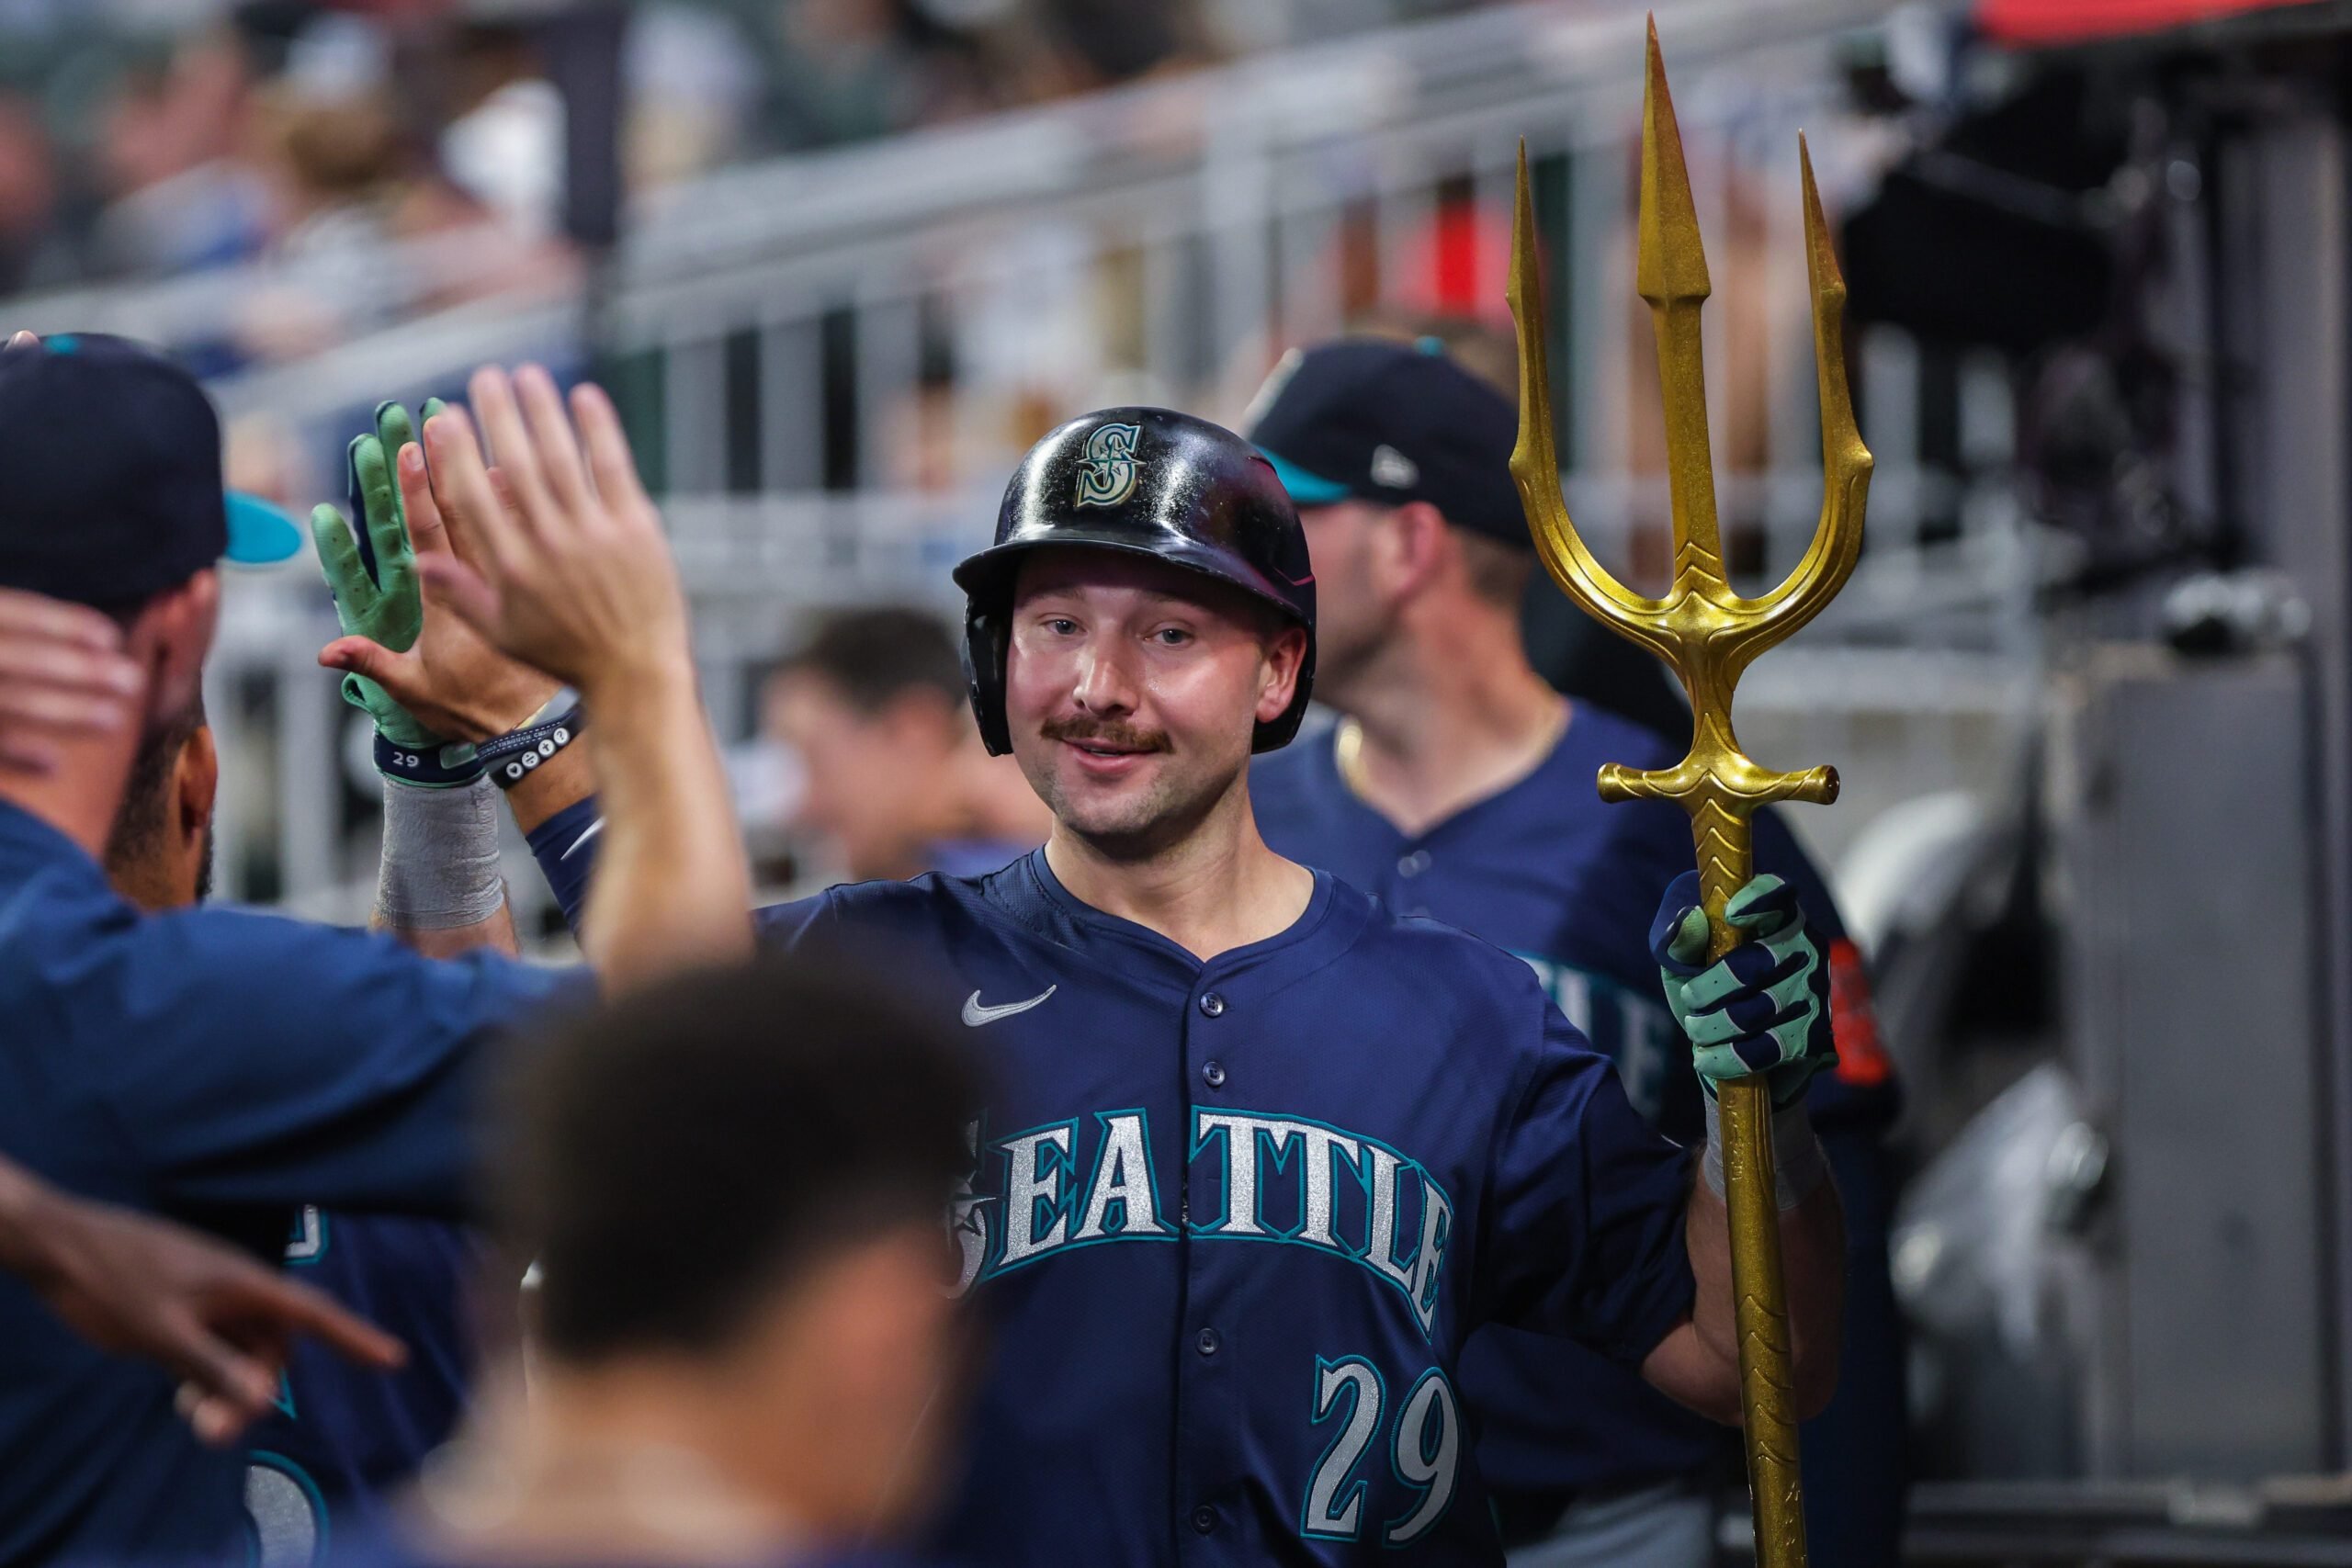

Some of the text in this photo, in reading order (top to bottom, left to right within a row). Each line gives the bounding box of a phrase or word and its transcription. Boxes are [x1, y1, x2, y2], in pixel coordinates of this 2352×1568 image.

[1075, 423, 1146, 508] S
[392, 750, 420, 768] 29
[1300, 1353, 1461, 1548] 29
